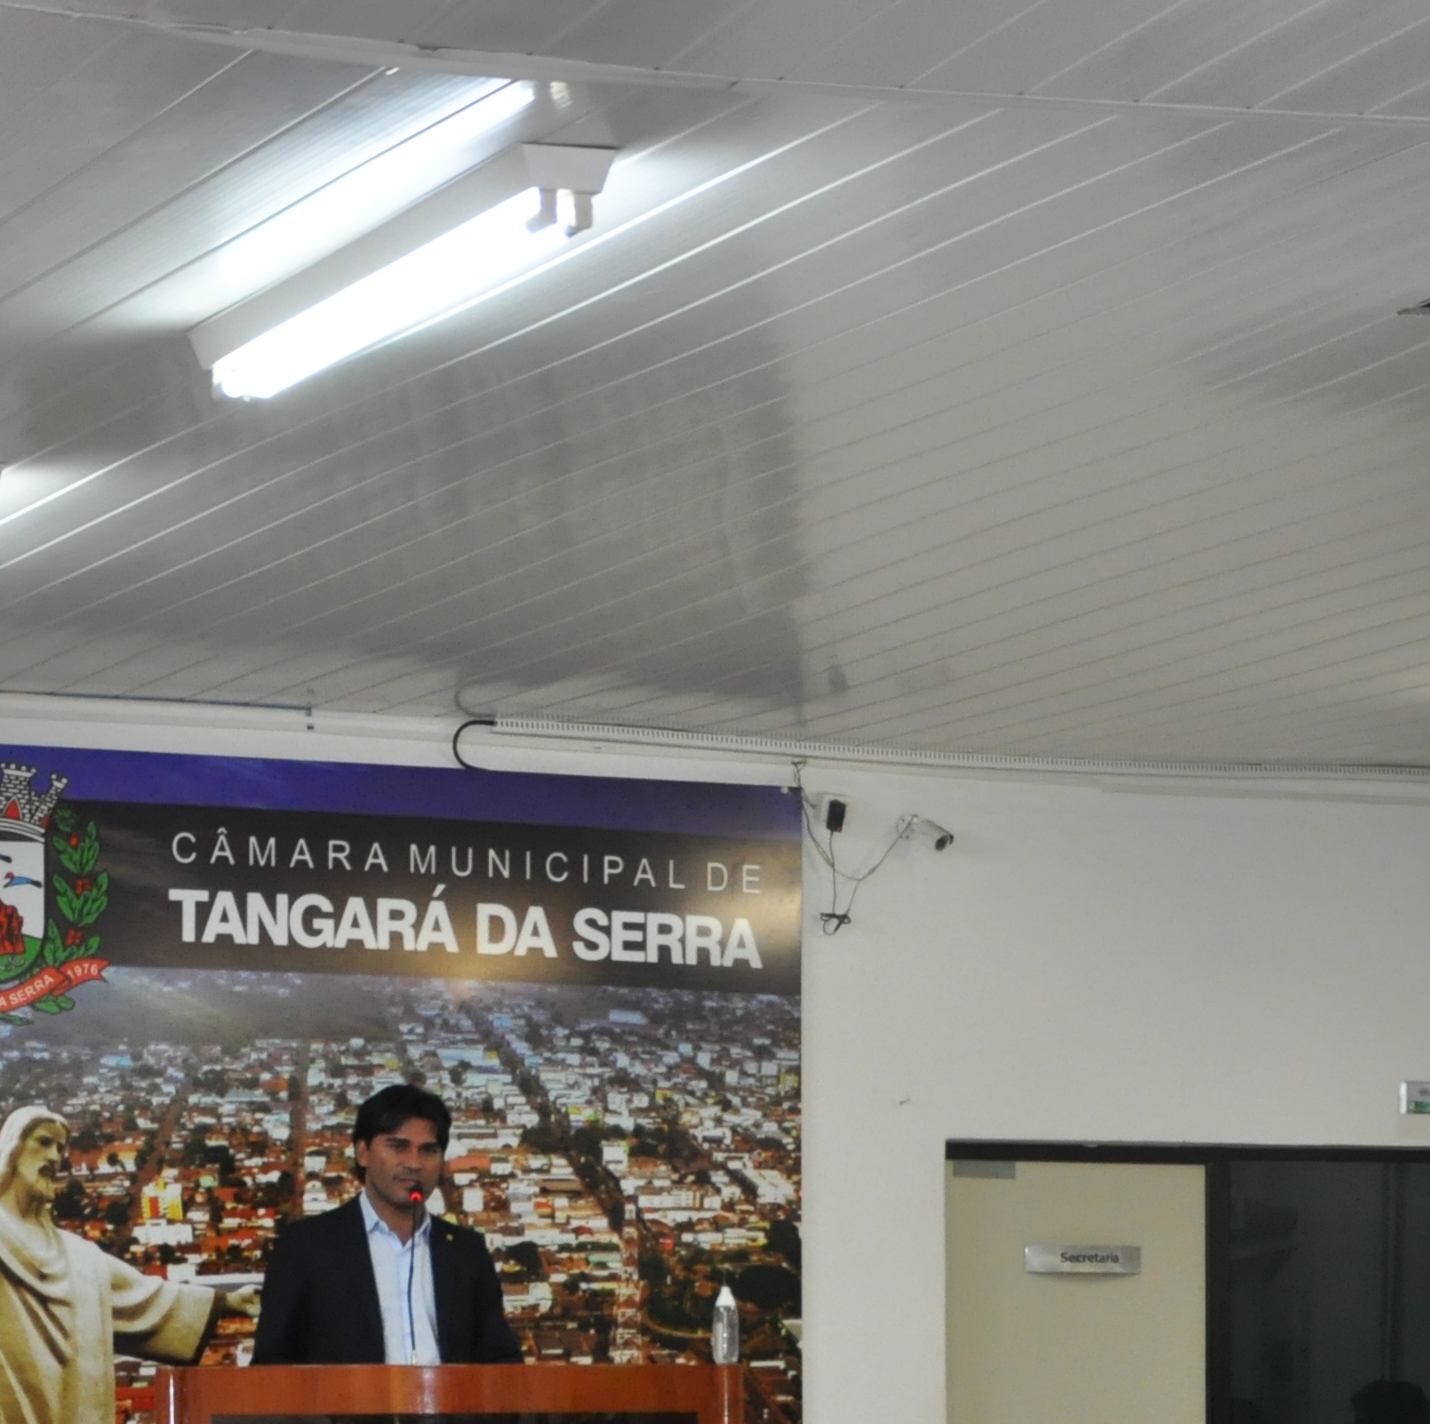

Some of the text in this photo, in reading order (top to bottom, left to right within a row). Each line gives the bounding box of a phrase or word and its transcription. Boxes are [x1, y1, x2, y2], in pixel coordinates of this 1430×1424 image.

[171, 826, 762, 894] CÂMARA MUNICIPAL DE
[168, 883, 764, 970] TANGARÁ DA SERRA
[67, 963, 99, 980] 1976
[9, 973, 55, 1006] SERRA
[1059, 1252, 1120, 1264] Secretaria
